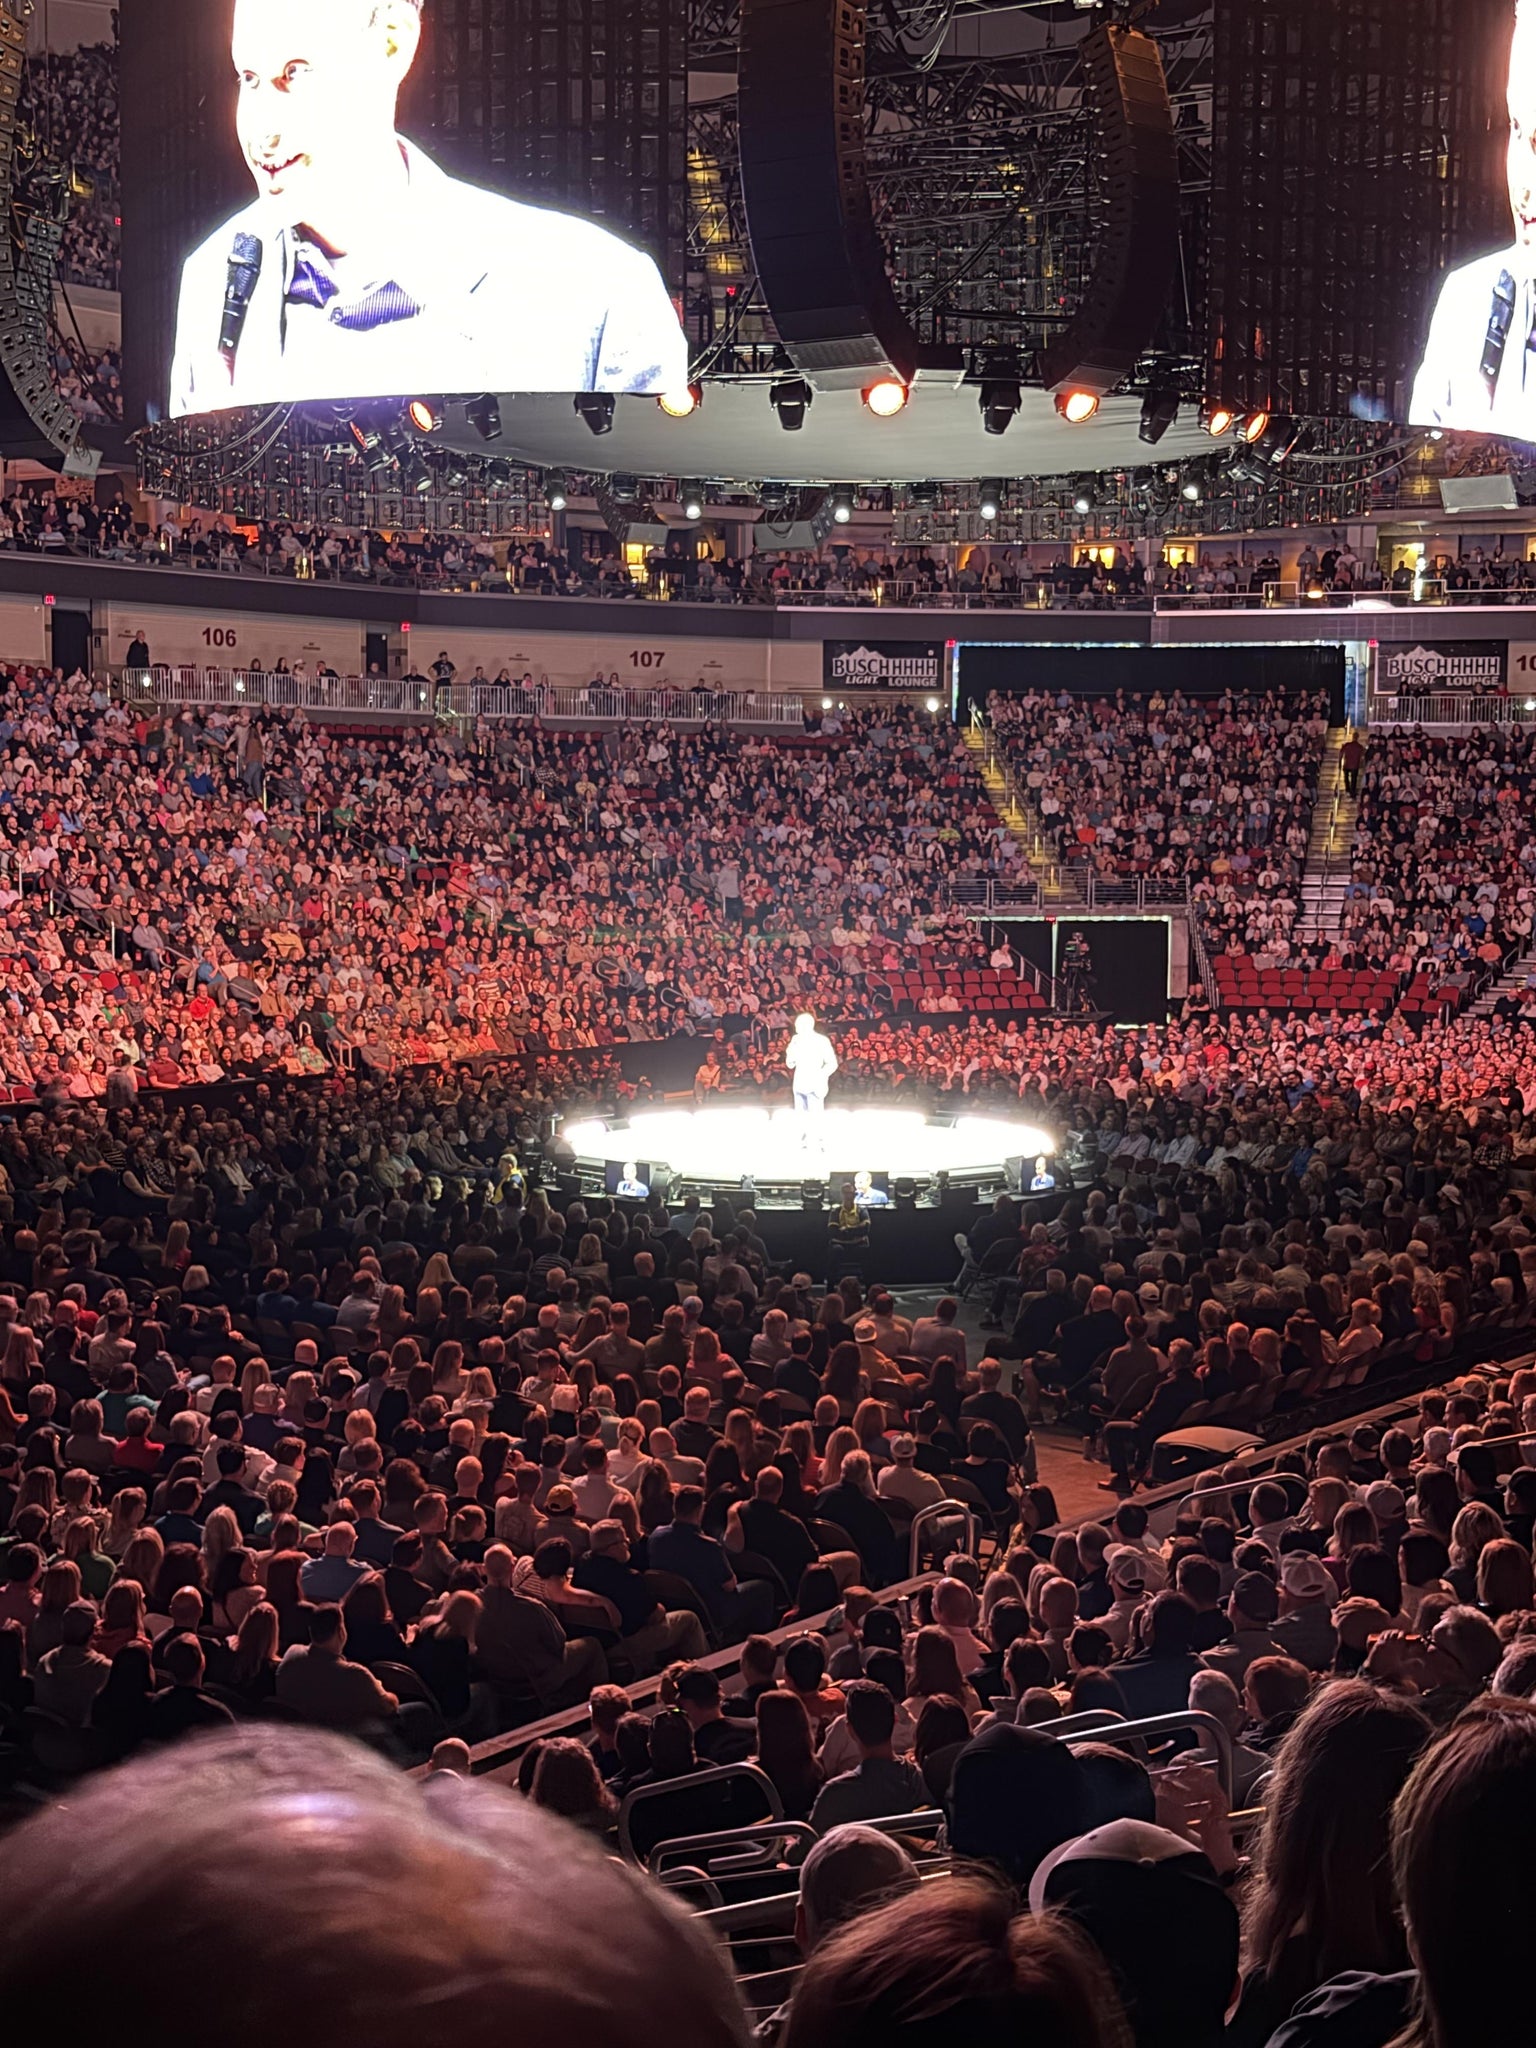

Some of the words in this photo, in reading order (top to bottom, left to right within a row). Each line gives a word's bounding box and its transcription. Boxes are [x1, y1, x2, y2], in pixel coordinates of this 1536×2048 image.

[202, 627, 237, 647] 106
[629, 650, 665, 668] 107
[832, 657, 938, 678] BUSCHHHHH
[1387, 656, 1500, 677] BUSCHHHHH
[845, 675, 878, 685] LIGHT
[888, 677, 937, 687] LOUNGE
[1446, 676, 1499, 687] LOUNGE
